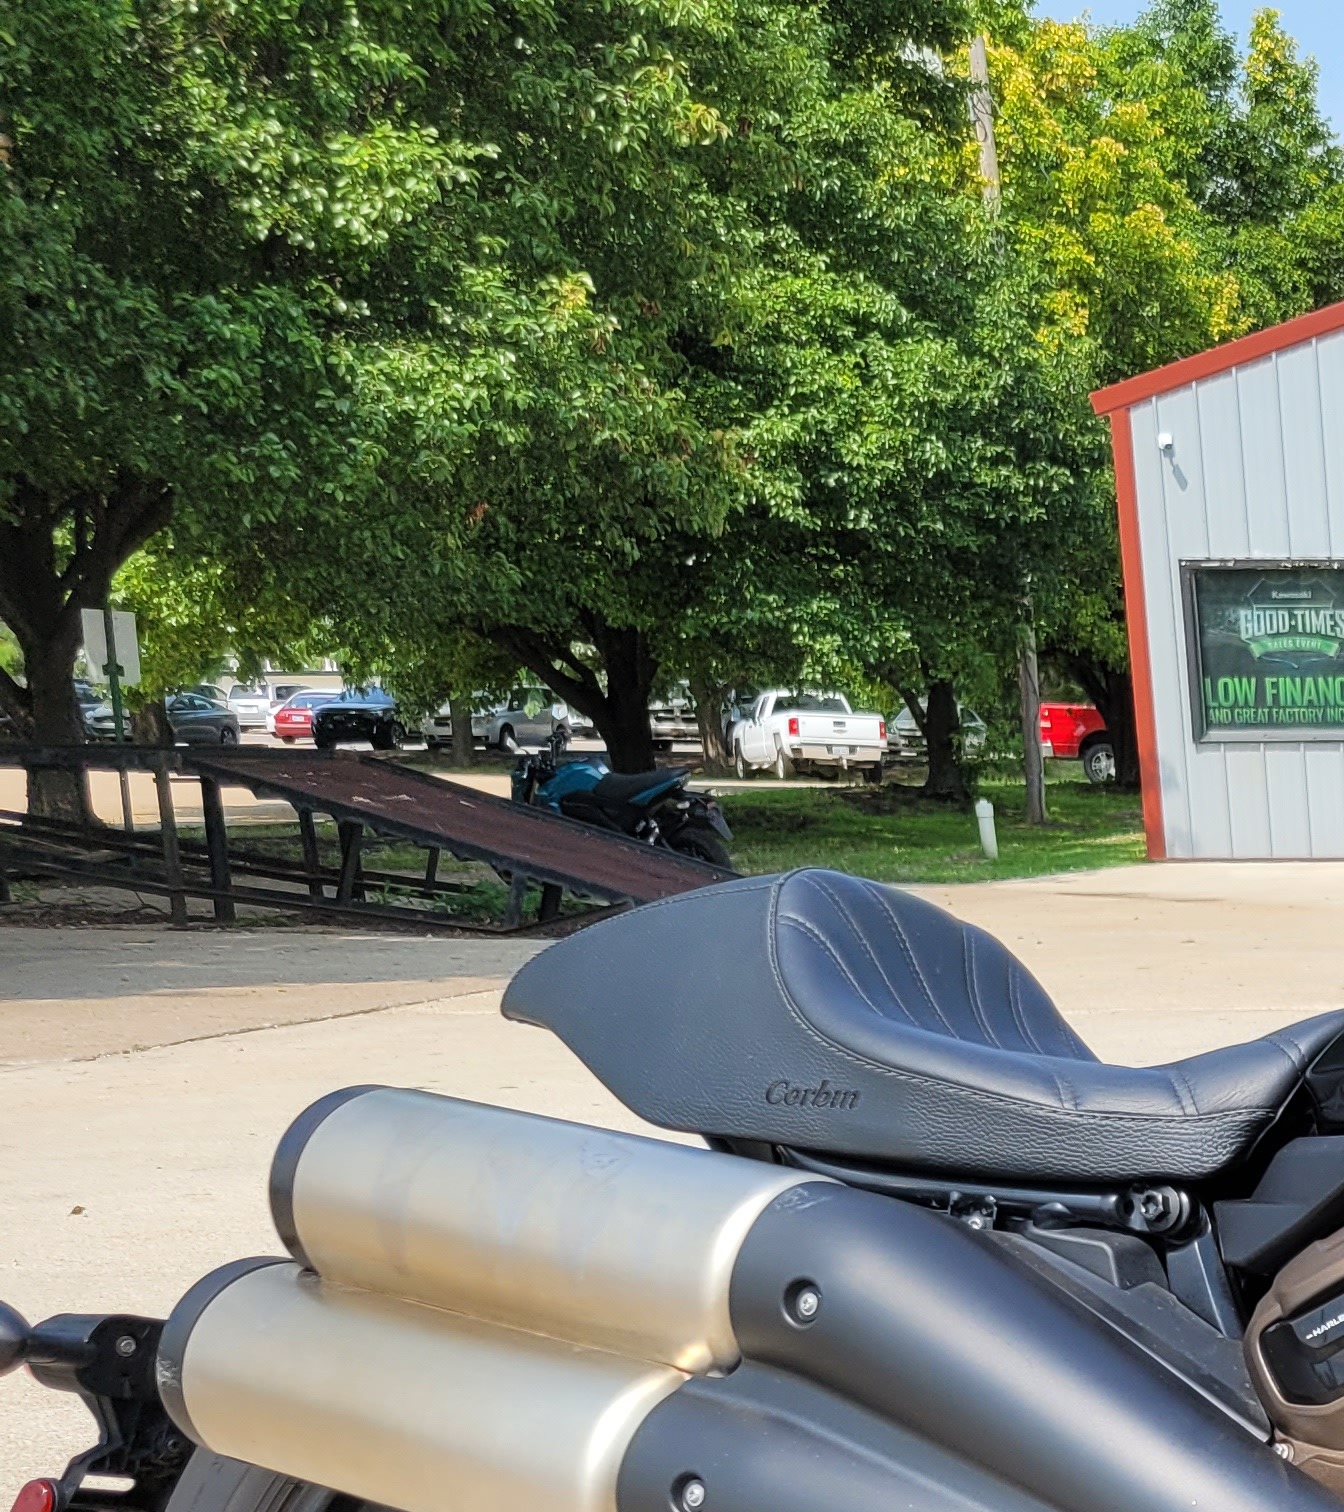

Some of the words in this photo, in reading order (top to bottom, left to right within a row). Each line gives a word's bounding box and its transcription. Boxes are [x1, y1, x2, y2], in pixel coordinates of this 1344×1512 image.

[1205, 676, 1257, 708] LOW
[1209, 708, 1232, 724] AND
[1234, 708, 1269, 724] GREAT
[1273, 707, 1324, 724] FACTORY
[765, 1079, 863, 1110] Corbin
